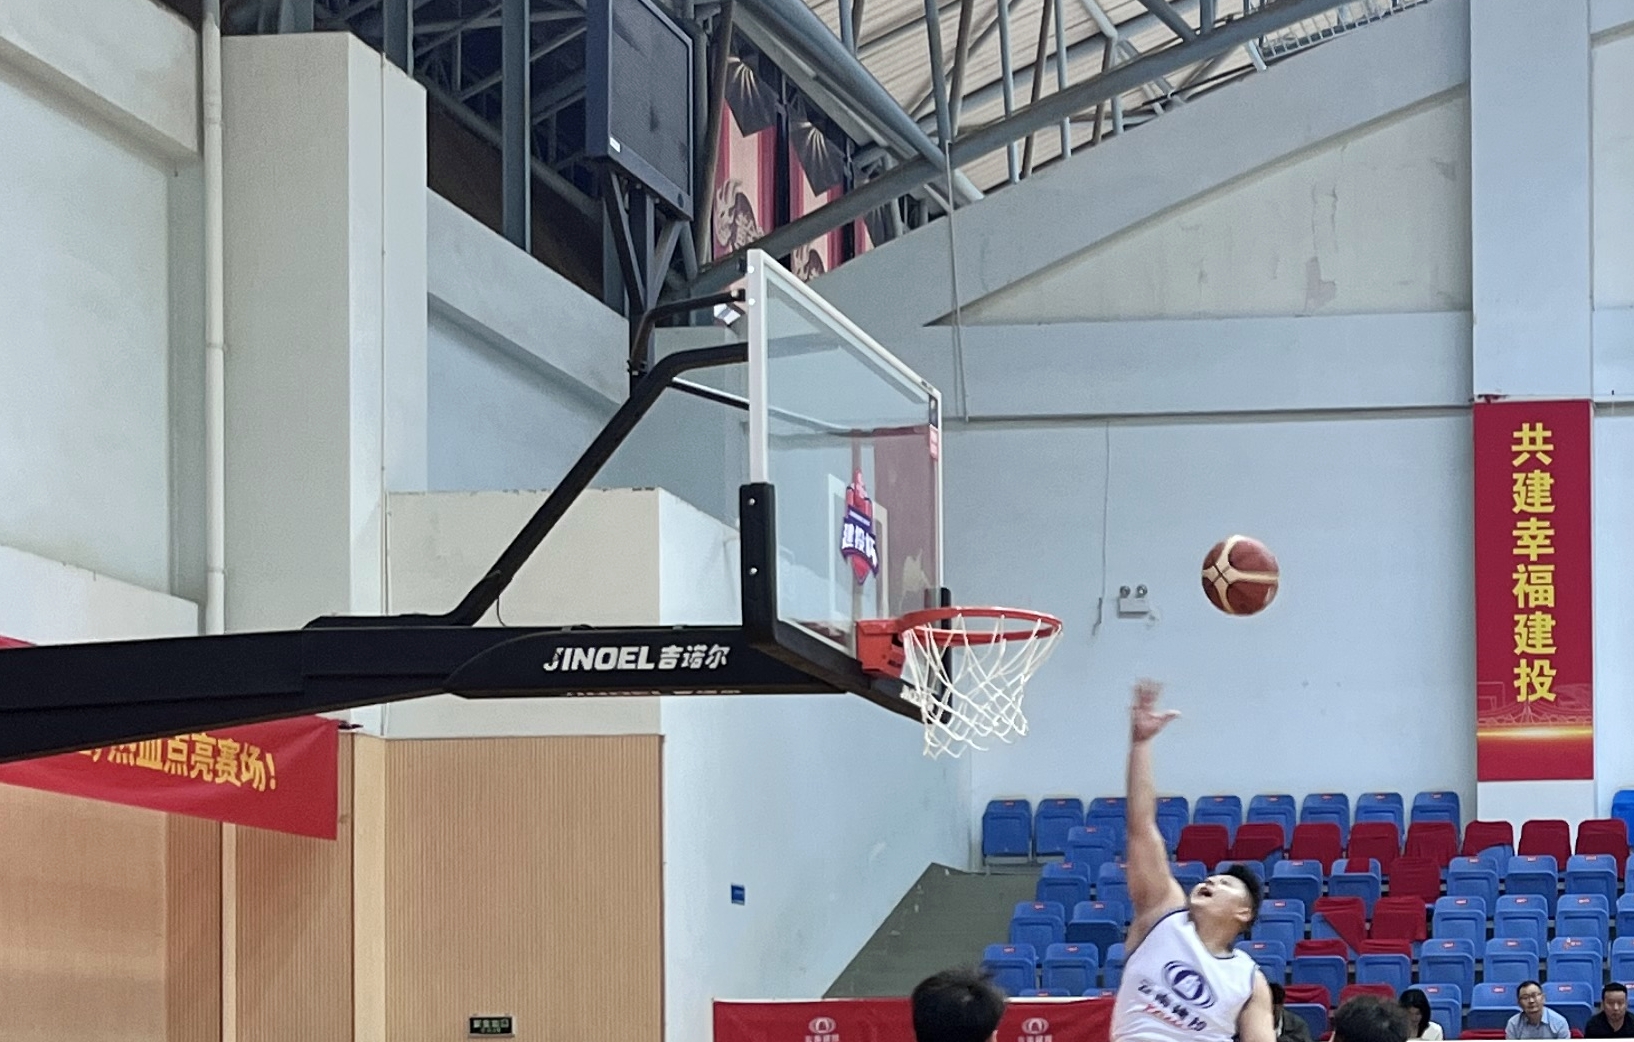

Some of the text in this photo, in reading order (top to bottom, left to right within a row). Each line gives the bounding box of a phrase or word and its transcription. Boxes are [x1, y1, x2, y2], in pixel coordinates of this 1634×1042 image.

[1511, 422, 1557, 702] 共建幸福建投
[543, 644, 730, 671] JINOEL 吉诺尔
